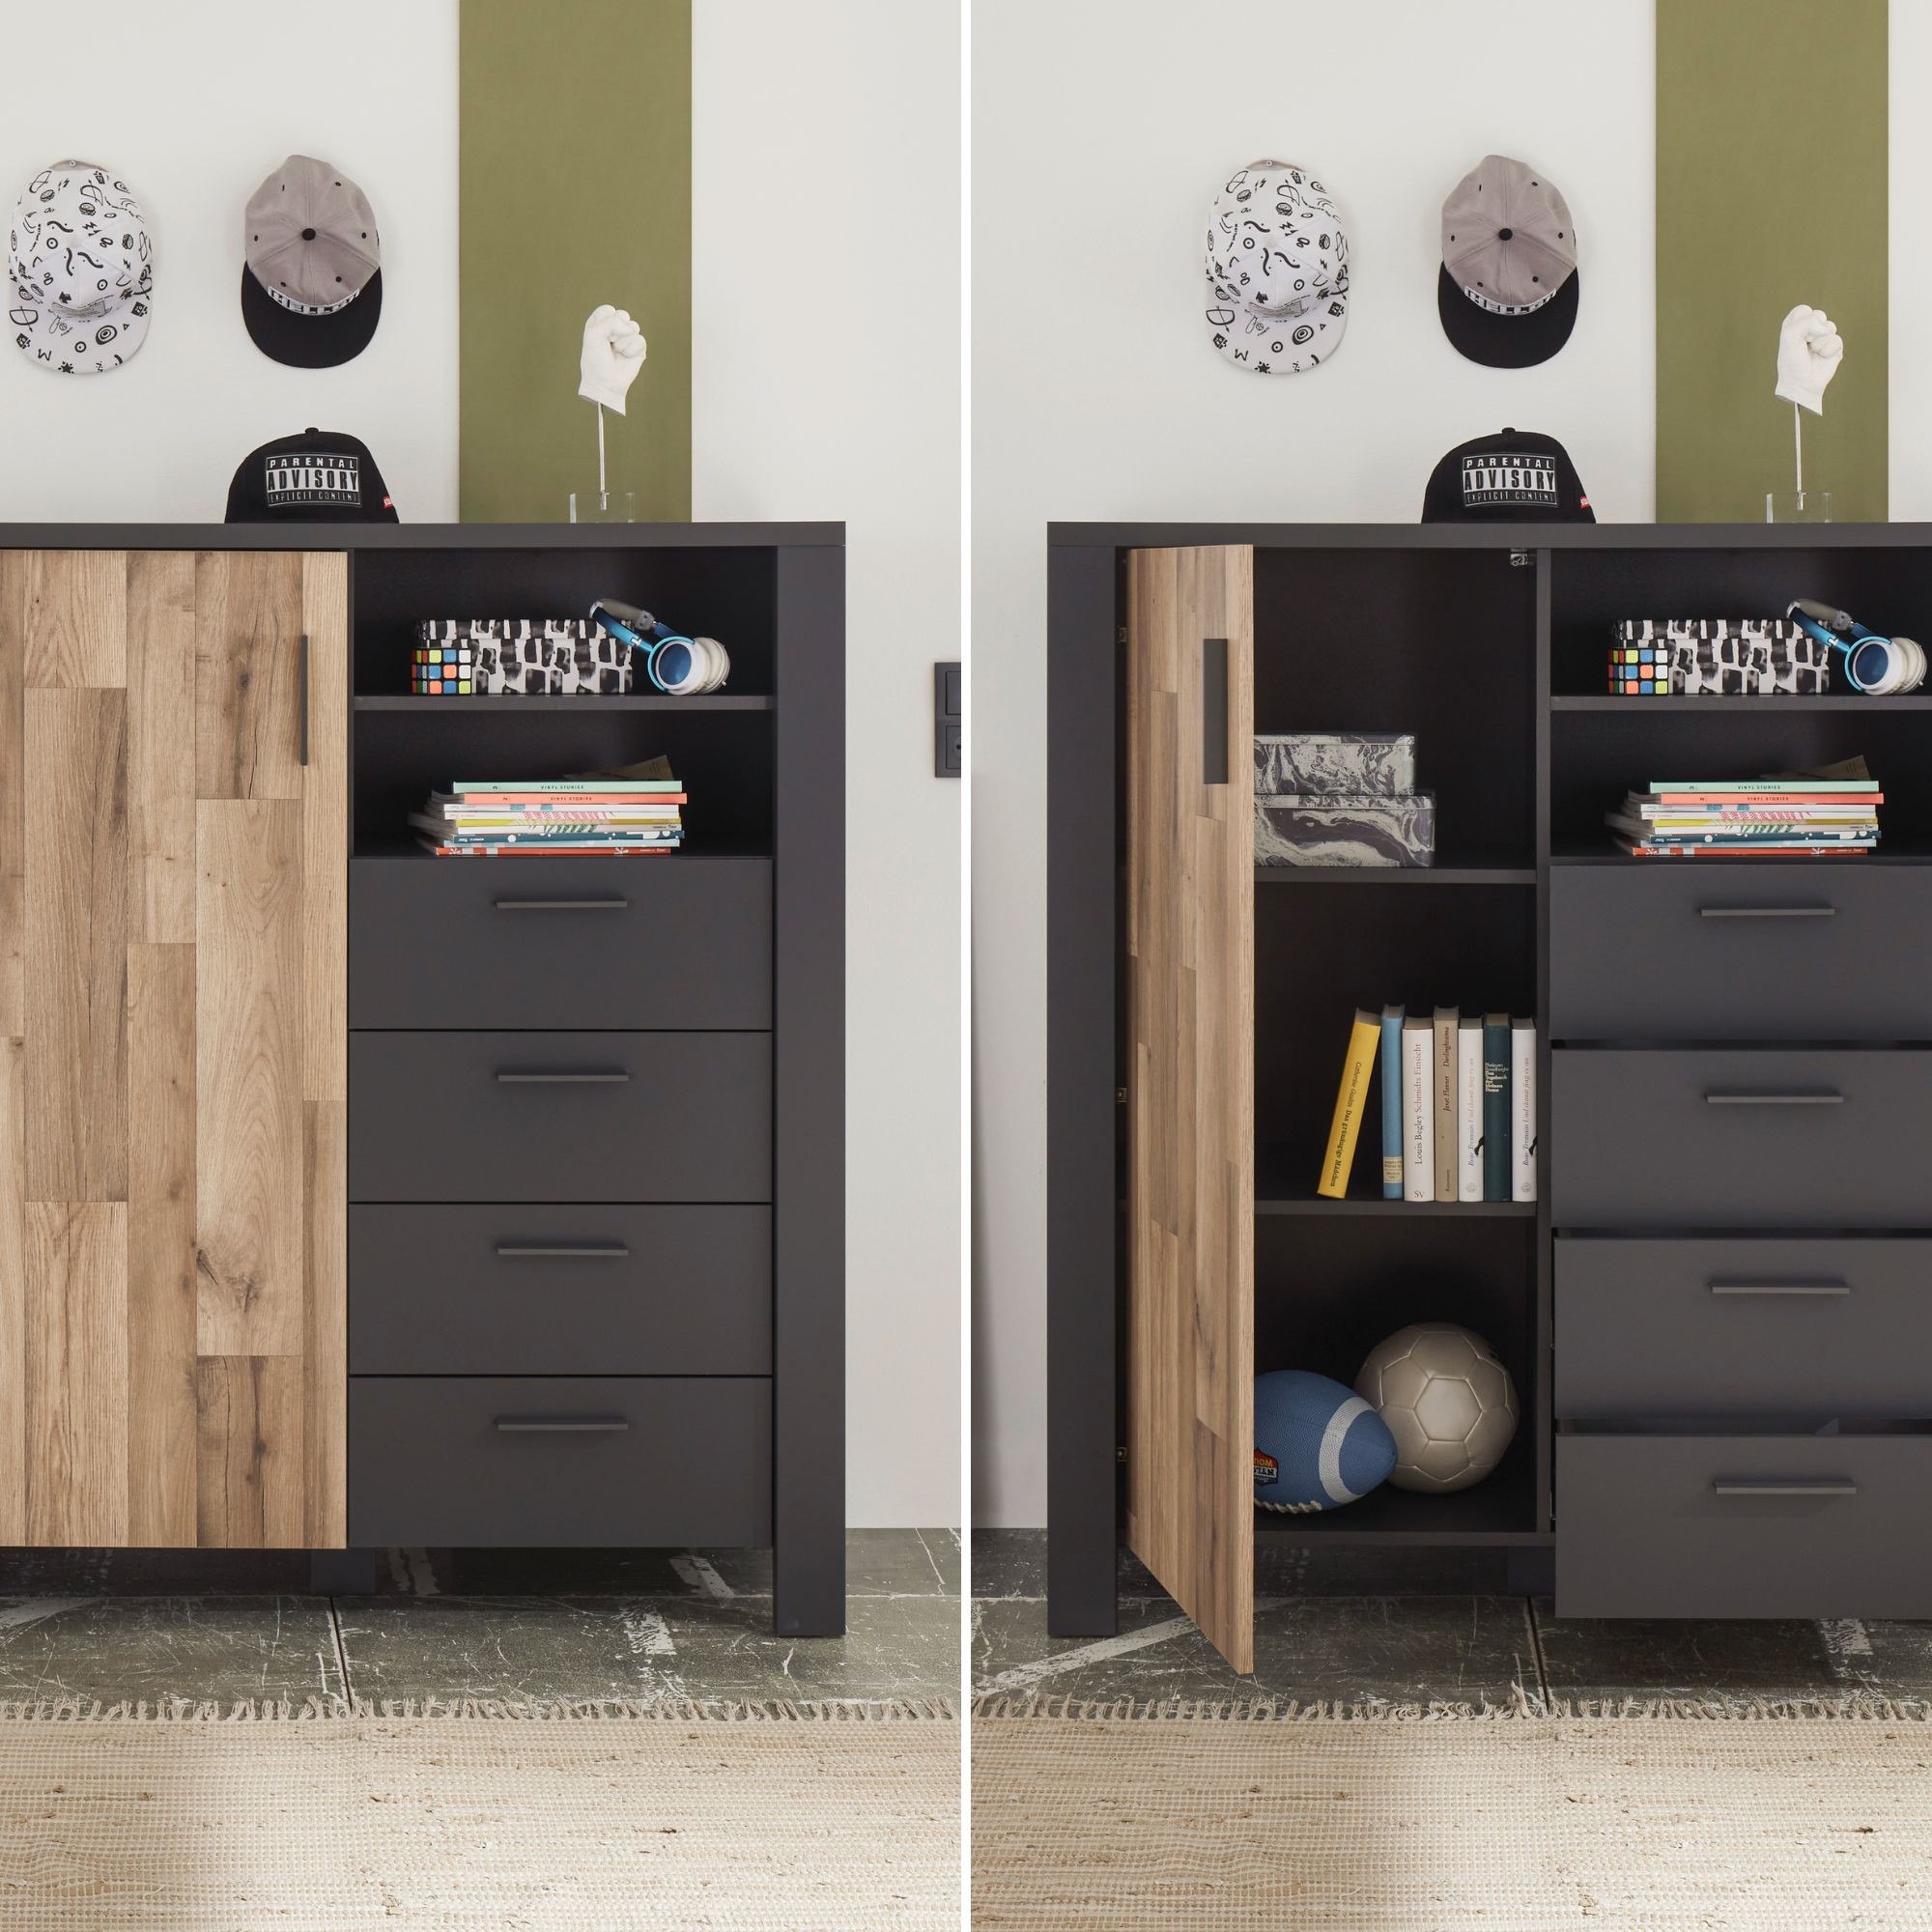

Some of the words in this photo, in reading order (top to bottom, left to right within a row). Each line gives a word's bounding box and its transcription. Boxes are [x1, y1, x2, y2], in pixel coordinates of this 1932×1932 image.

[270, 457, 354, 469] PARENTAL
[1466, 457, 1550, 469] PARENTAL
[268, 469, 357, 491] ADVISORY
[1464, 469, 1554, 491] ADVISORY
[270, 491, 312, 502] EXPLICIT
[318, 491, 357, 502] CONTENT
[1467, 491, 1508, 502] EXPLICIT
[1515, 491, 1554, 502] CONTENT
[1414, 1044, 1422, 1075] Einsicht
[1414, 1077, 1422, 1113] Schmidts
[1443, 1098, 1451, 1111] Janet
[1414, 1115, 1424, 1140] Begley
[1414, 1142, 1422, 1164] Louis
